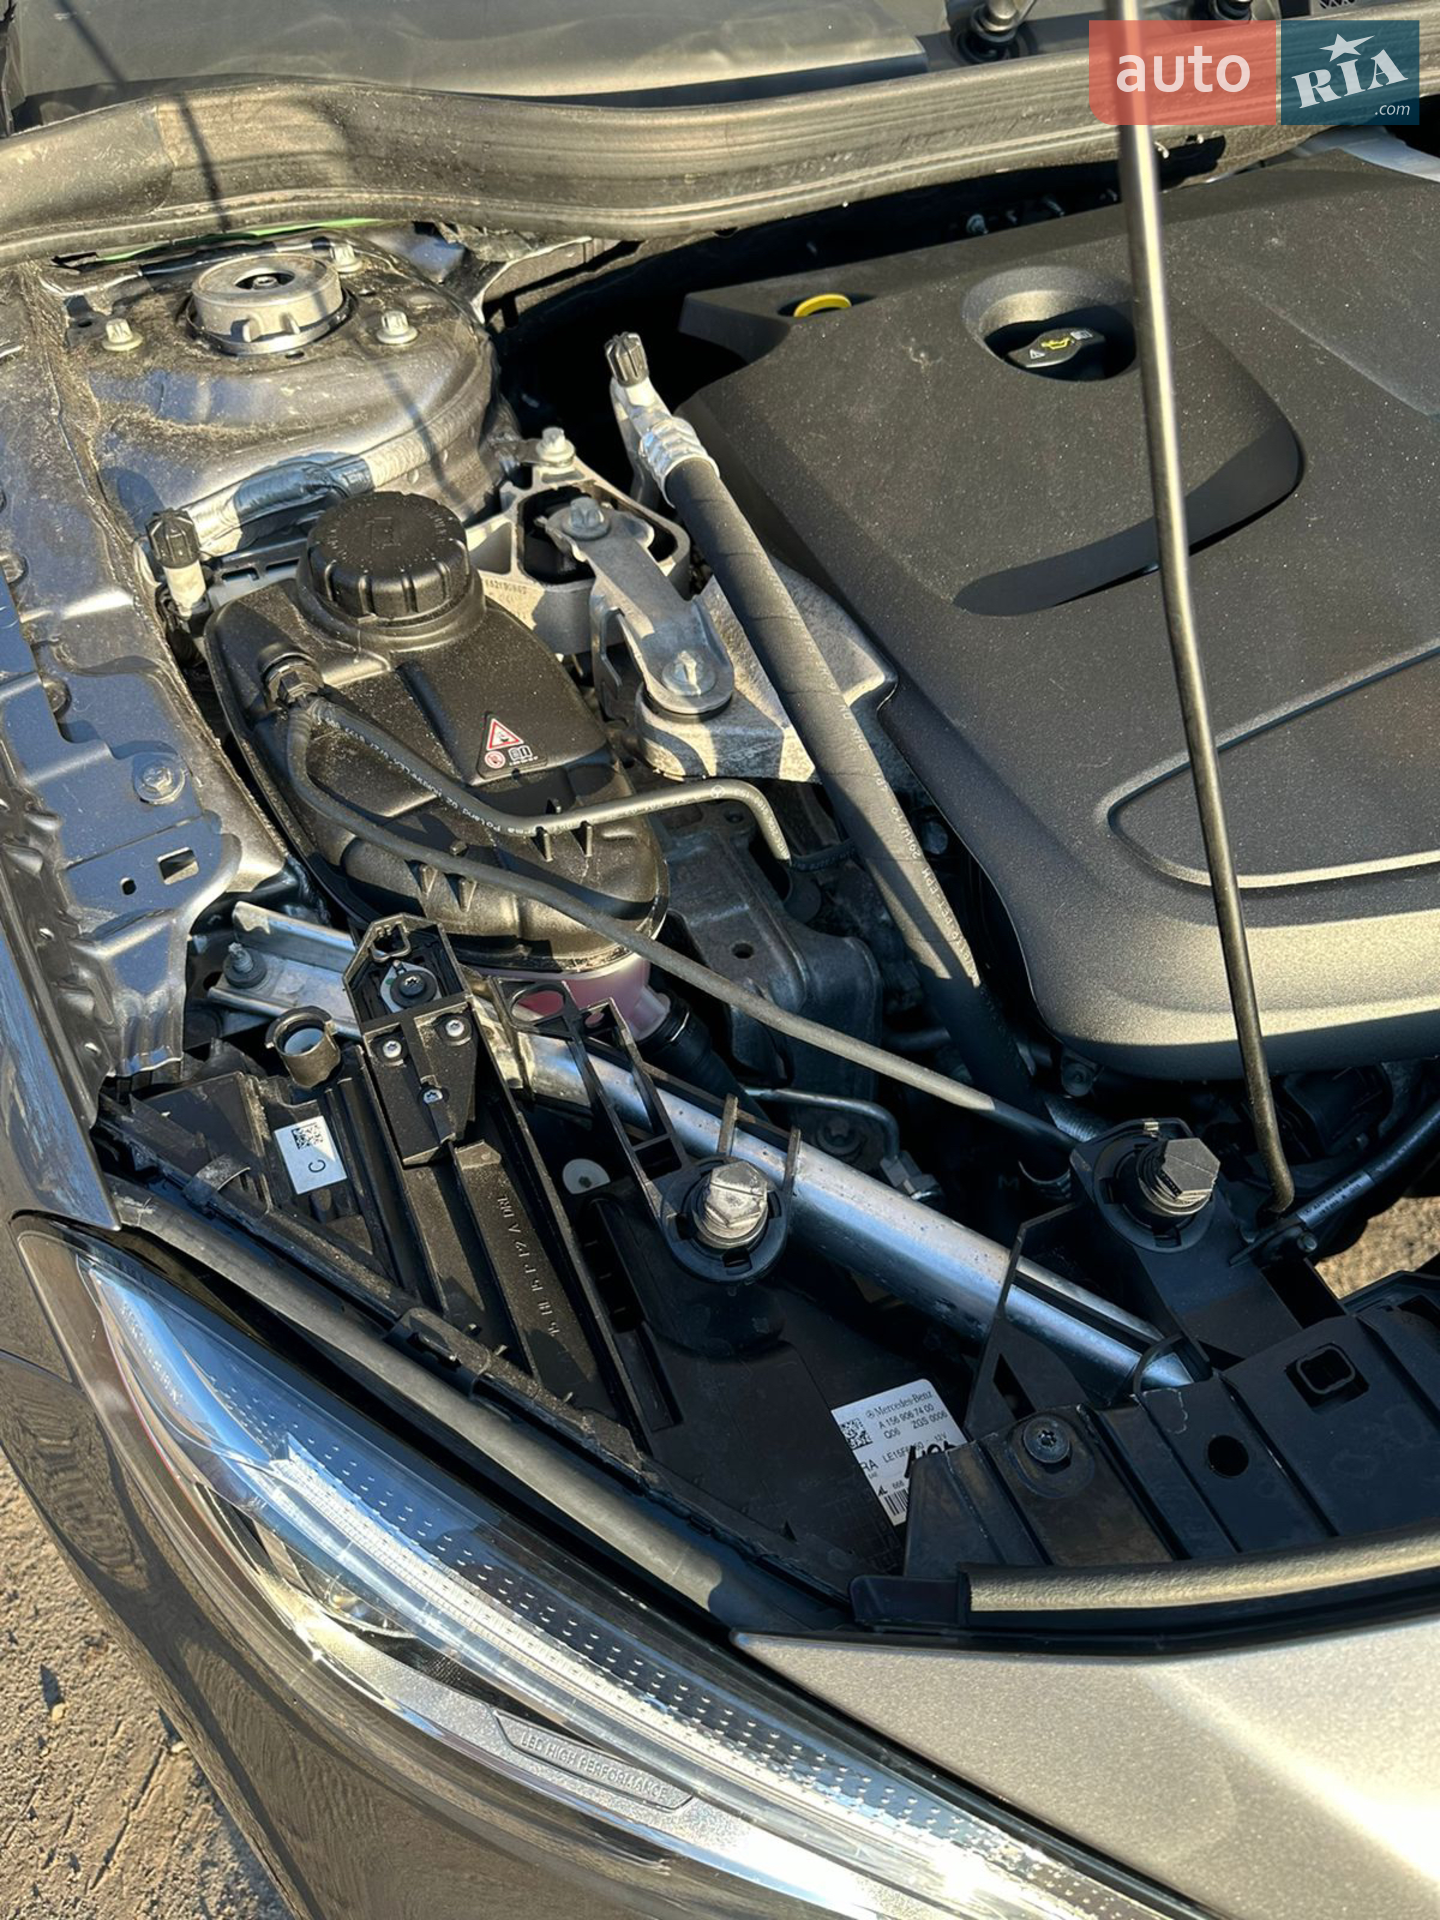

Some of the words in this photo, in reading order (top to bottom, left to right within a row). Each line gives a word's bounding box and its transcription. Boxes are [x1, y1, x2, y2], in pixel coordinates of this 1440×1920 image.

[308, 1159, 326, 1173] C
[874, 1391, 933, 1416] Mercedes-Benz
[879, 1421, 886, 1429] A
[912, 1418, 930, 1429] ZGS
[520, 1732, 543, 1751] LED
[545, 1740, 579, 1765] HIGH
[579, 1754, 669, 1801] PERFORMANCE
